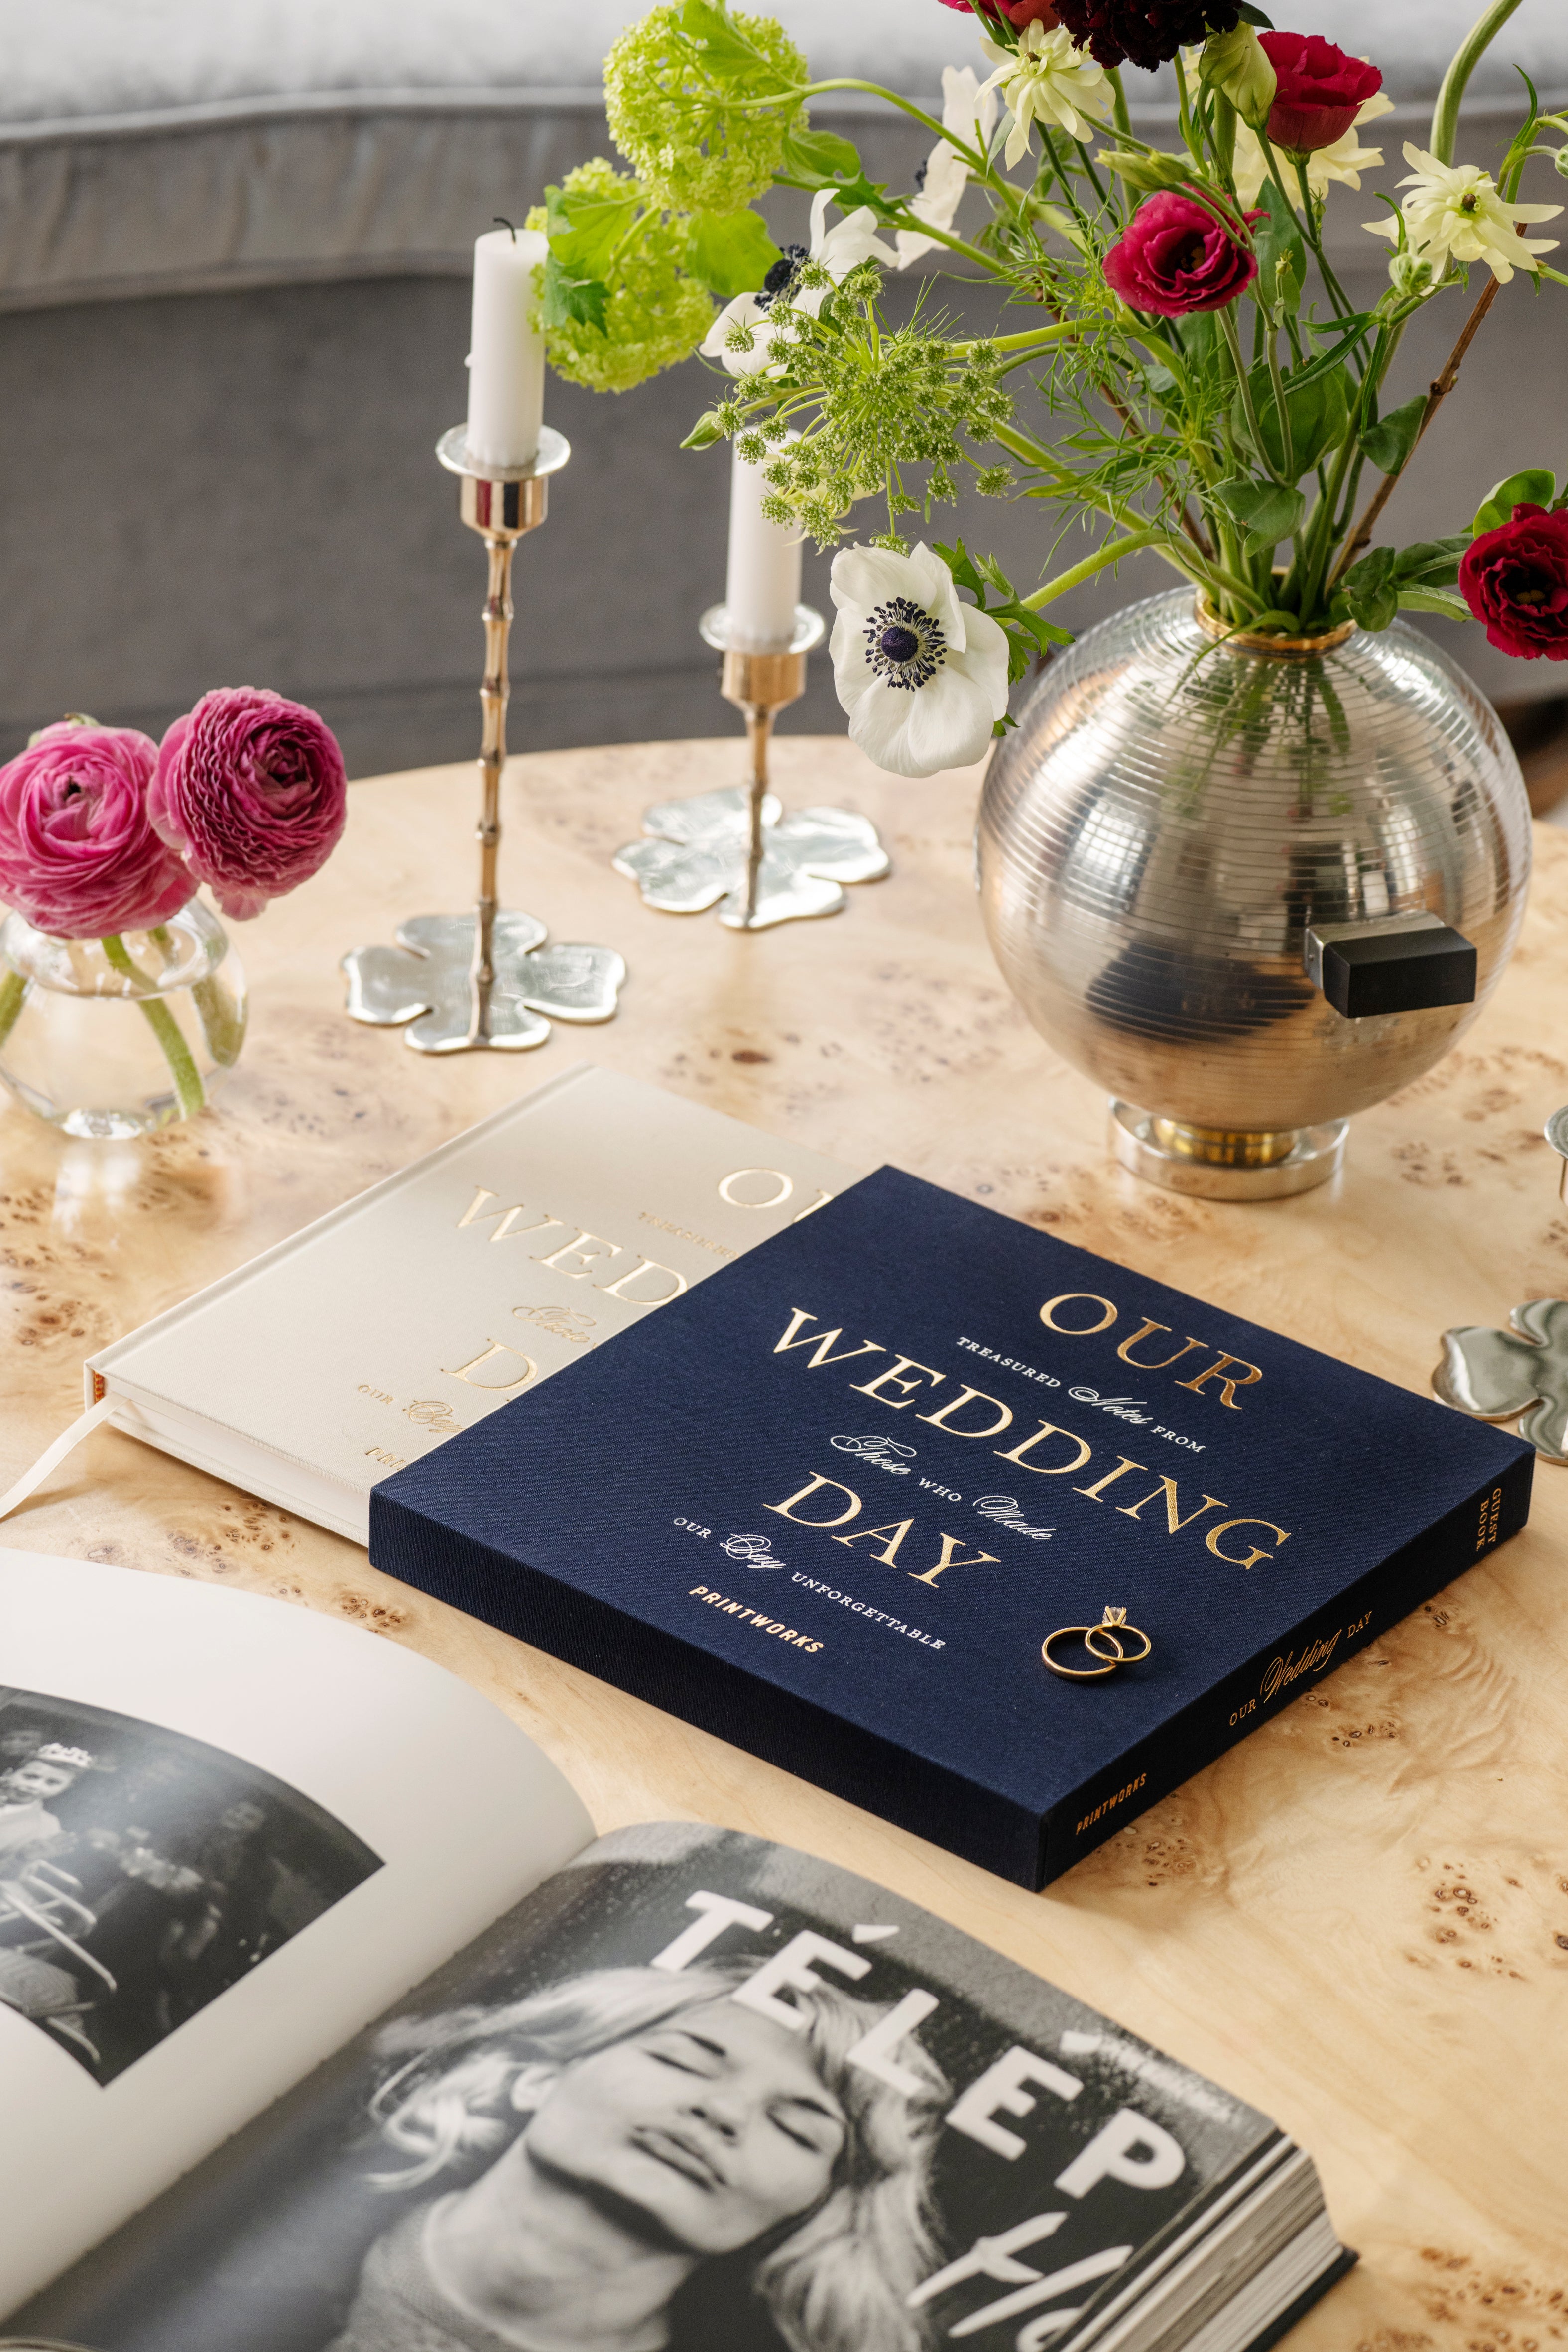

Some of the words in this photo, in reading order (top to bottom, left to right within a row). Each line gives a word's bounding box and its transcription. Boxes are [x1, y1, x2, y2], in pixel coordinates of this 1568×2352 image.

[638, 1211, 740, 1259] TREASURED
[512, 1306, 597, 1343] Those
[1039, 1293, 1263, 1410] OUR
[357, 1384, 395, 1405] OUR
[956, 1336, 1061, 1388] TREASURED
[1068, 1386, 1154, 1424] Notes
[1150, 1425, 1206, 1453] FROM
[364, 1447, 407, 1470] PRI
[772, 1307, 1292, 1570] WEDDING
[830, 1435, 917, 1475] Those
[918, 1477, 962, 1501] WHO
[972, 1495, 1057, 1540] Made
[1488, 1488, 1502, 1543] GUEST
[763, 1471, 1001, 1589] DAY
[1476, 1498, 1489, 1552] BOOK
[672, 1517, 712, 1539] OUR
[719, 1533, 786, 1569] Day
[791, 1572, 947, 1650] UNFORGETTABLE
[688, 1585, 825, 1653] PRINTWORKS
[1229, 1698, 1257, 1726] OUR
[1260, 1629, 1342, 1704] Wedding
[1347, 1611, 1372, 1639] DAY
[1076, 1772, 1147, 1836] PRINTWORKS
